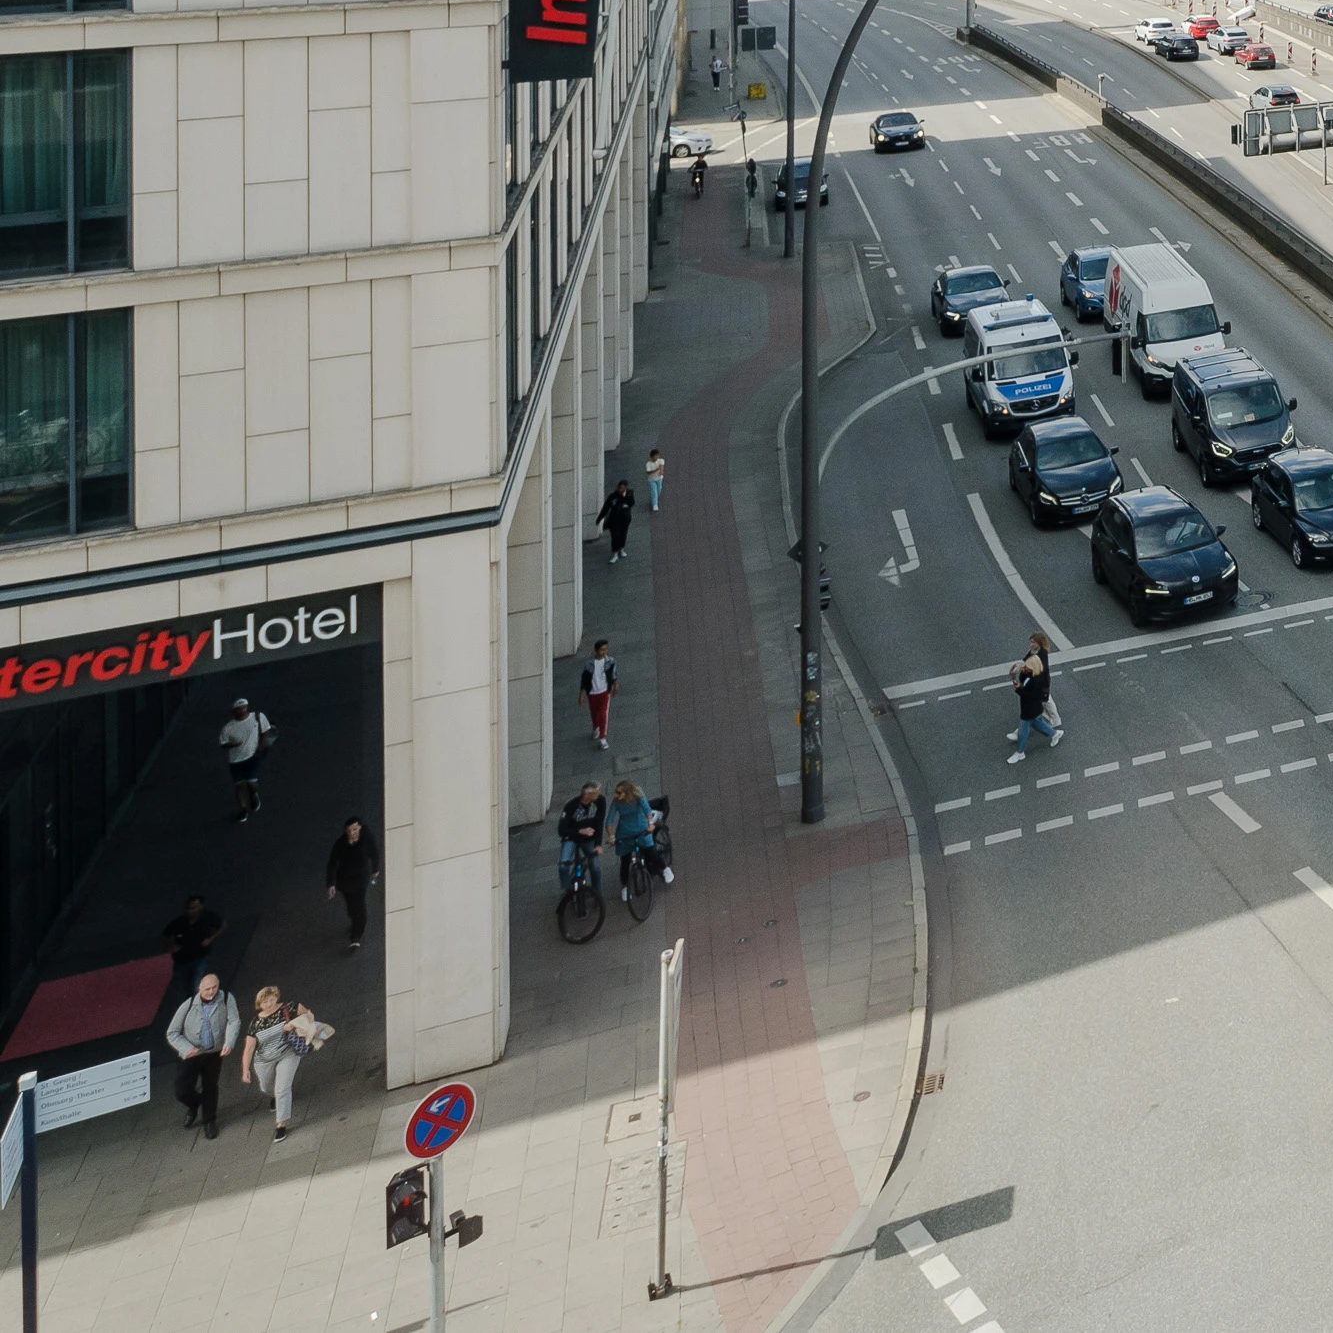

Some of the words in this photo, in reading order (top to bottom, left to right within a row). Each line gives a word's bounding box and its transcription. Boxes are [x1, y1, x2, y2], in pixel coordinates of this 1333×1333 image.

[1015, 383, 1052, 395] POLIZEI
[53, 1074, 77, 1086] Georg
[40, 1085, 65, 1097] Lange
[40, 1109, 82, 1126] Kunsthalle
